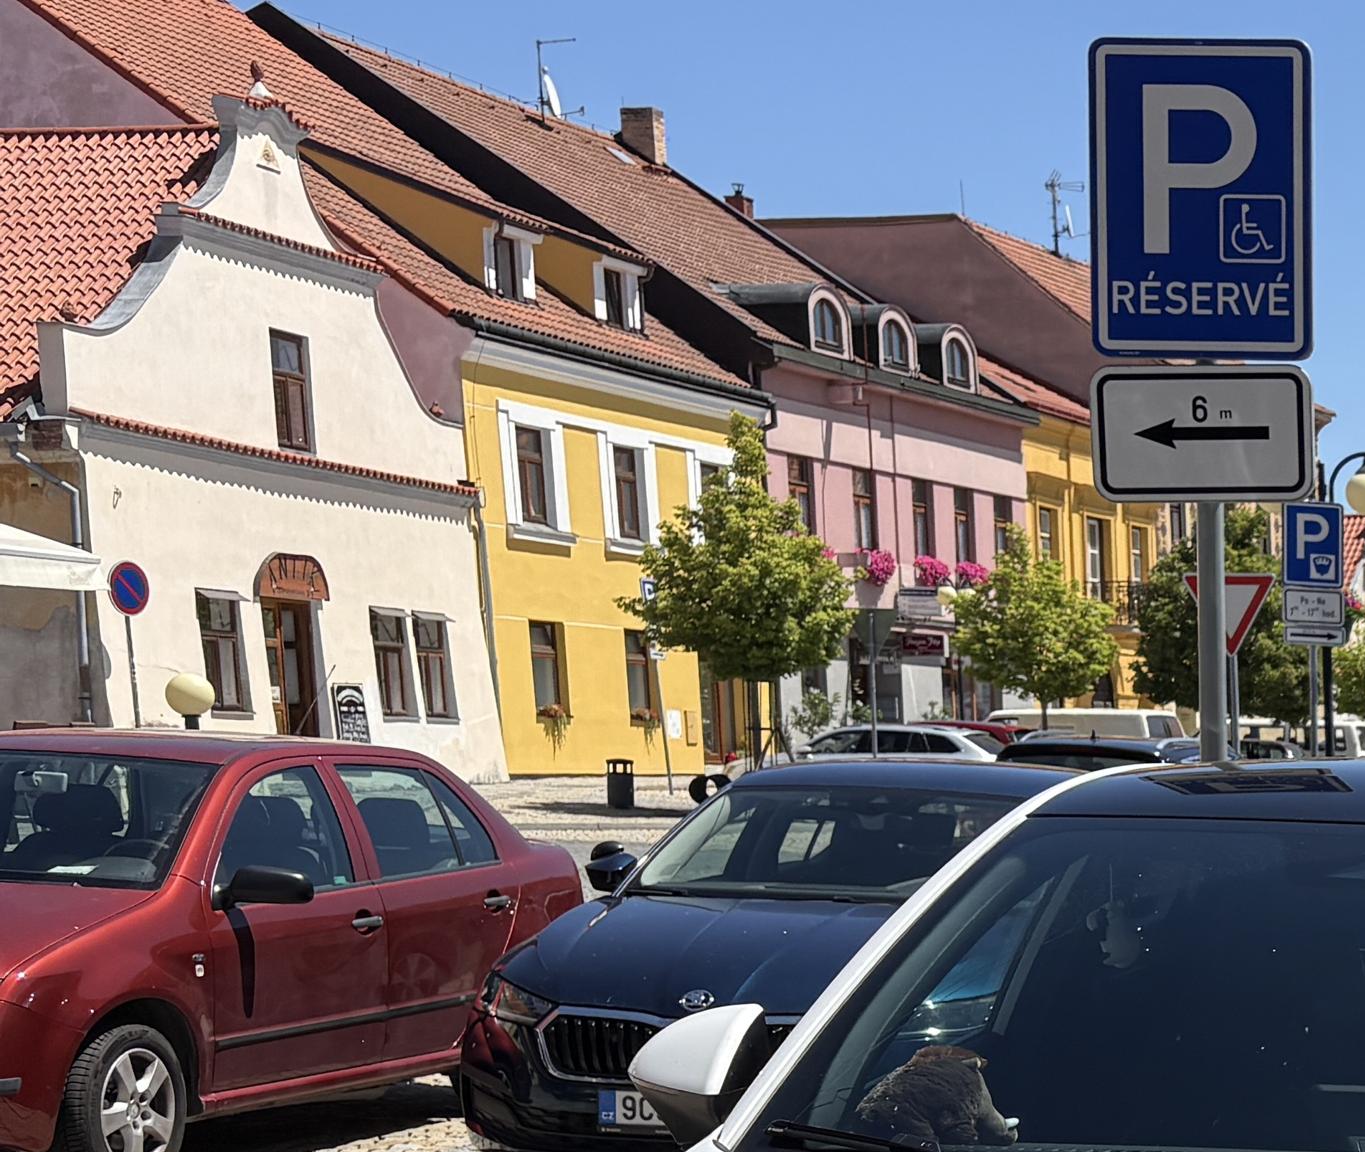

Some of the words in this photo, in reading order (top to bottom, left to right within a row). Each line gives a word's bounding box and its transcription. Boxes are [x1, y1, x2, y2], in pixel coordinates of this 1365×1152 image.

[1142, 84, 1257, 254] P
[1112, 271, 1291, 316] RÉSERVÉ
[1191, 396, 1208, 423] 6
[1219, 407, 1232, 419] m
[1296, 513, 1330, 559] P
[601, 1112, 614, 1120] CZ
[622, 1095, 657, 1121] 9C
